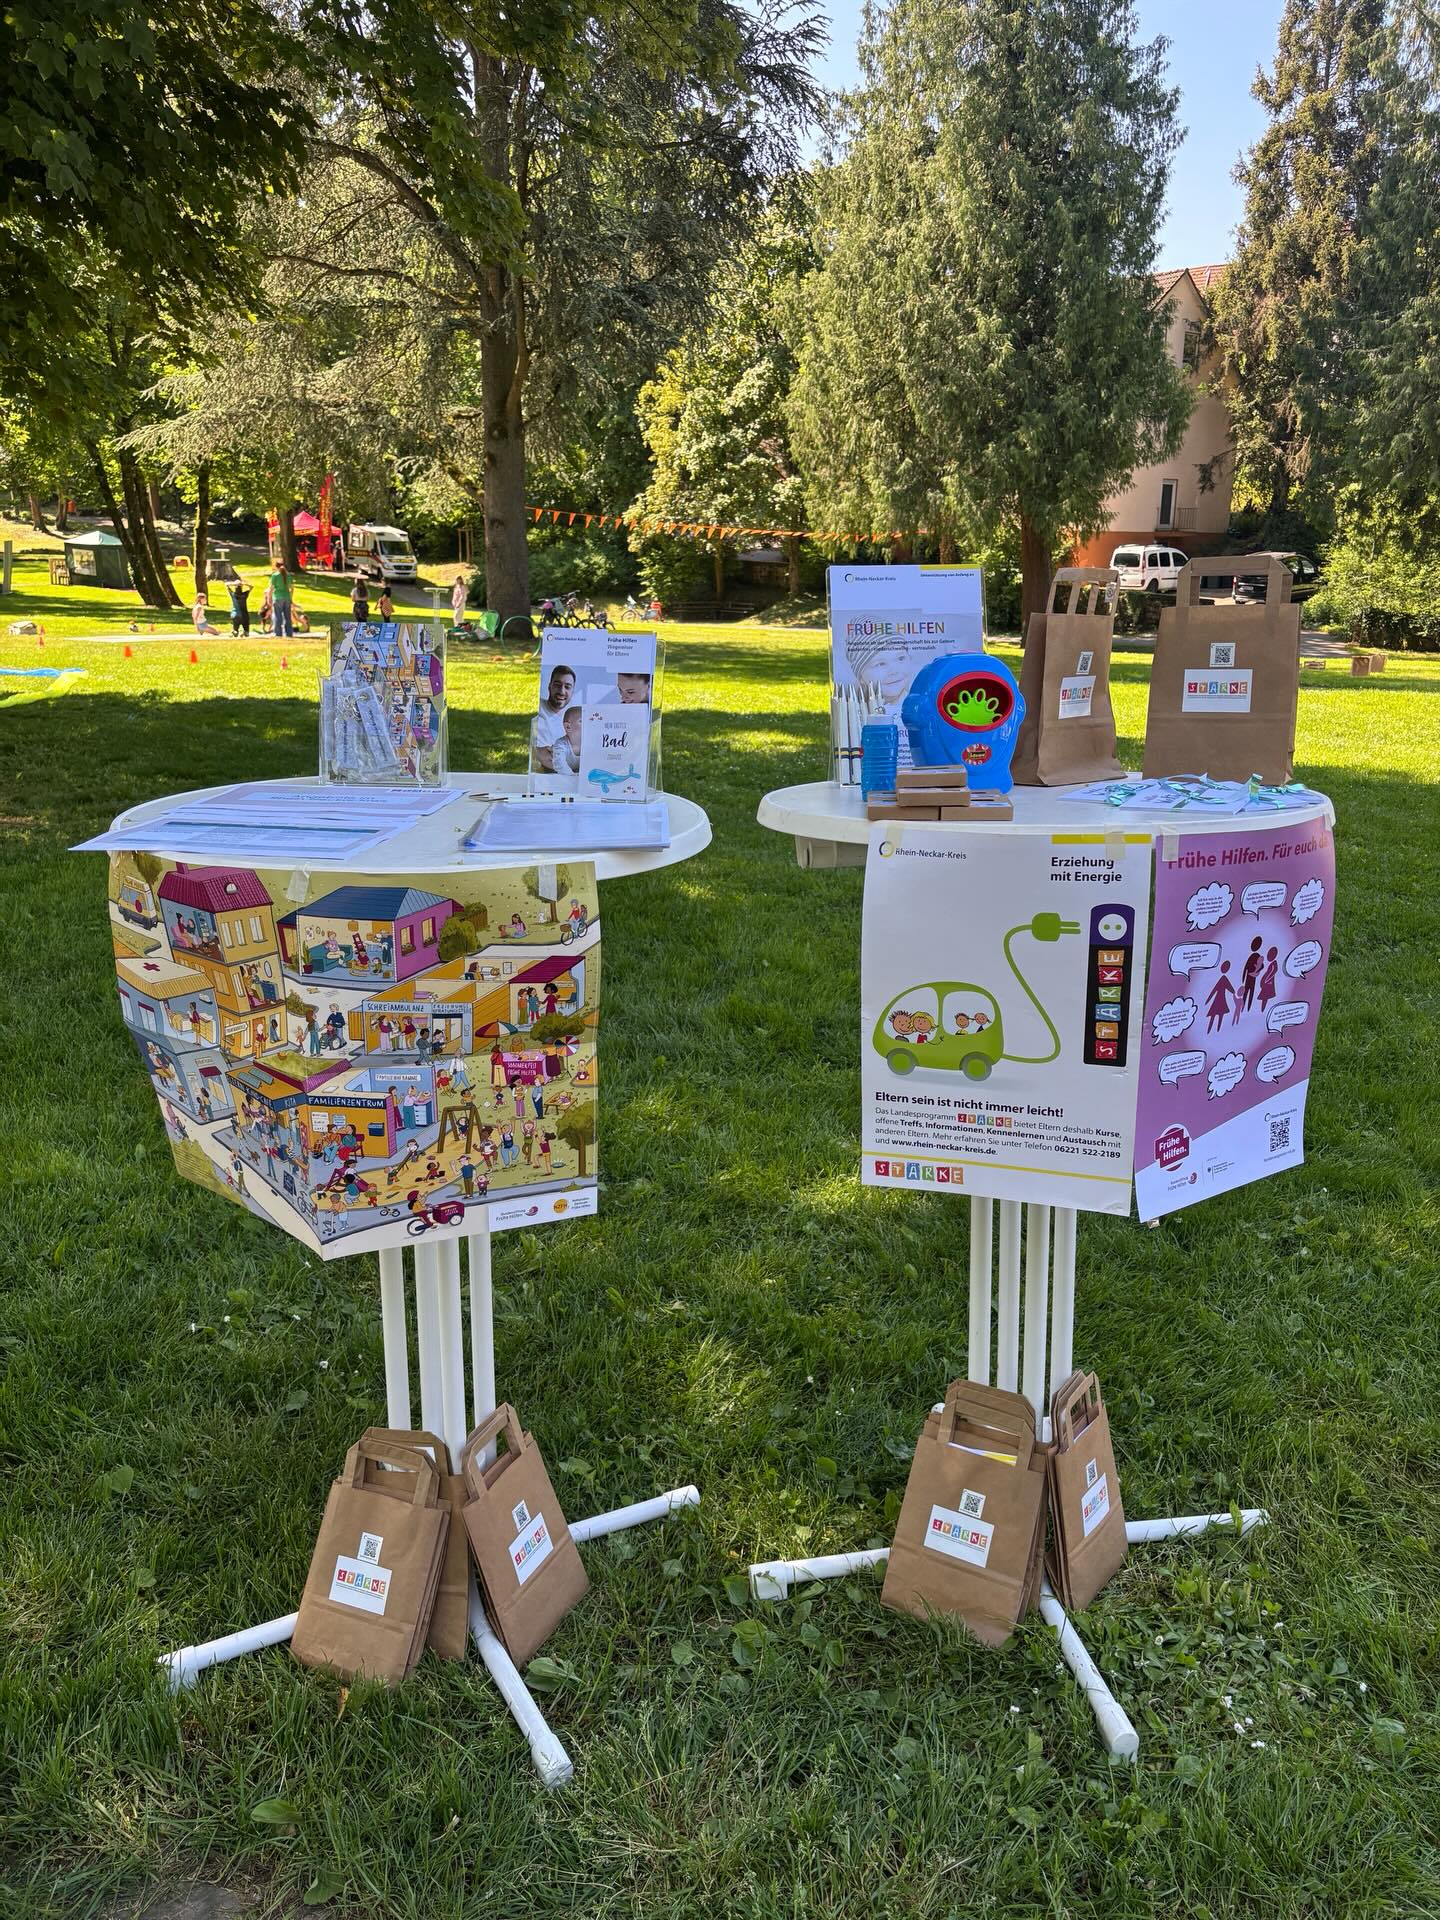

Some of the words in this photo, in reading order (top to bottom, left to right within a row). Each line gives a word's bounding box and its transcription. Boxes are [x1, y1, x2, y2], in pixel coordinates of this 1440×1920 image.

[847, 621, 892, 635] FRÜHE
[896, 622, 945, 635] HILFEN
[602, 731, 629, 748] Bad
[895, 847, 967, 860] Rhein-Neckar-Kreis
[1221, 847, 1269, 866] Hilfen.
[1272, 842, 1293, 860] Für
[1294, 832, 1318, 856] euch
[1050, 856, 1115, 871] Erziehung
[1050, 871, 1072, 883] mit
[1074, 871, 1122, 885] Energie
[284, 1097, 297, 1109] KITA
[875, 1091, 909, 1103] Eltern
[911, 1096, 934, 1106] sein
[938, 1097, 951, 1107] ist
[953, 1099, 983, 1110] nicht
[985, 1101, 1024, 1114] immer
[1027, 1105, 1064, 1118] leicht!
[875, 1107, 889, 1115] Das
[890, 1107, 956, 1121] Landesprogramm
[1013, 1120, 1036, 1129] bietet
[1038, 1122, 1061, 1132] Eltern
[1062, 1126, 1093, 1135] deshalb
[1095, 1129, 1122, 1139] Kurse,
[875, 1117, 899, 1126] offene
[900, 1119, 924, 1129] Treffs,
[925, 1122, 986, 1134] Informationen,
[986, 1128, 1045, 1140] Kennenlernen
[1046, 1134, 1061, 1142] und
[1062, 1136, 1106, 1147] Austausch
[1107, 1141, 1121, 1149] mit
[875, 1137, 890, 1145] und
[875, 1128, 906, 1137] anderen
[907, 1130, 931, 1139] Eltern.
[932, 1132, 953, 1141] Mehr
[954, 1134, 986, 1144] erfahren
[988, 1138, 1000, 1146] Sie
[1001, 1140, 1022, 1148] unter
[1024, 1141, 1053, 1151] Telefon
[1054, 1145, 1080, 1154] 06221
[1082, 1148, 1121, 1158] 522-2189
[1159, 1137, 1181, 1152] Frühe
[1163, 1147, 1187, 1162] Hilfen.
